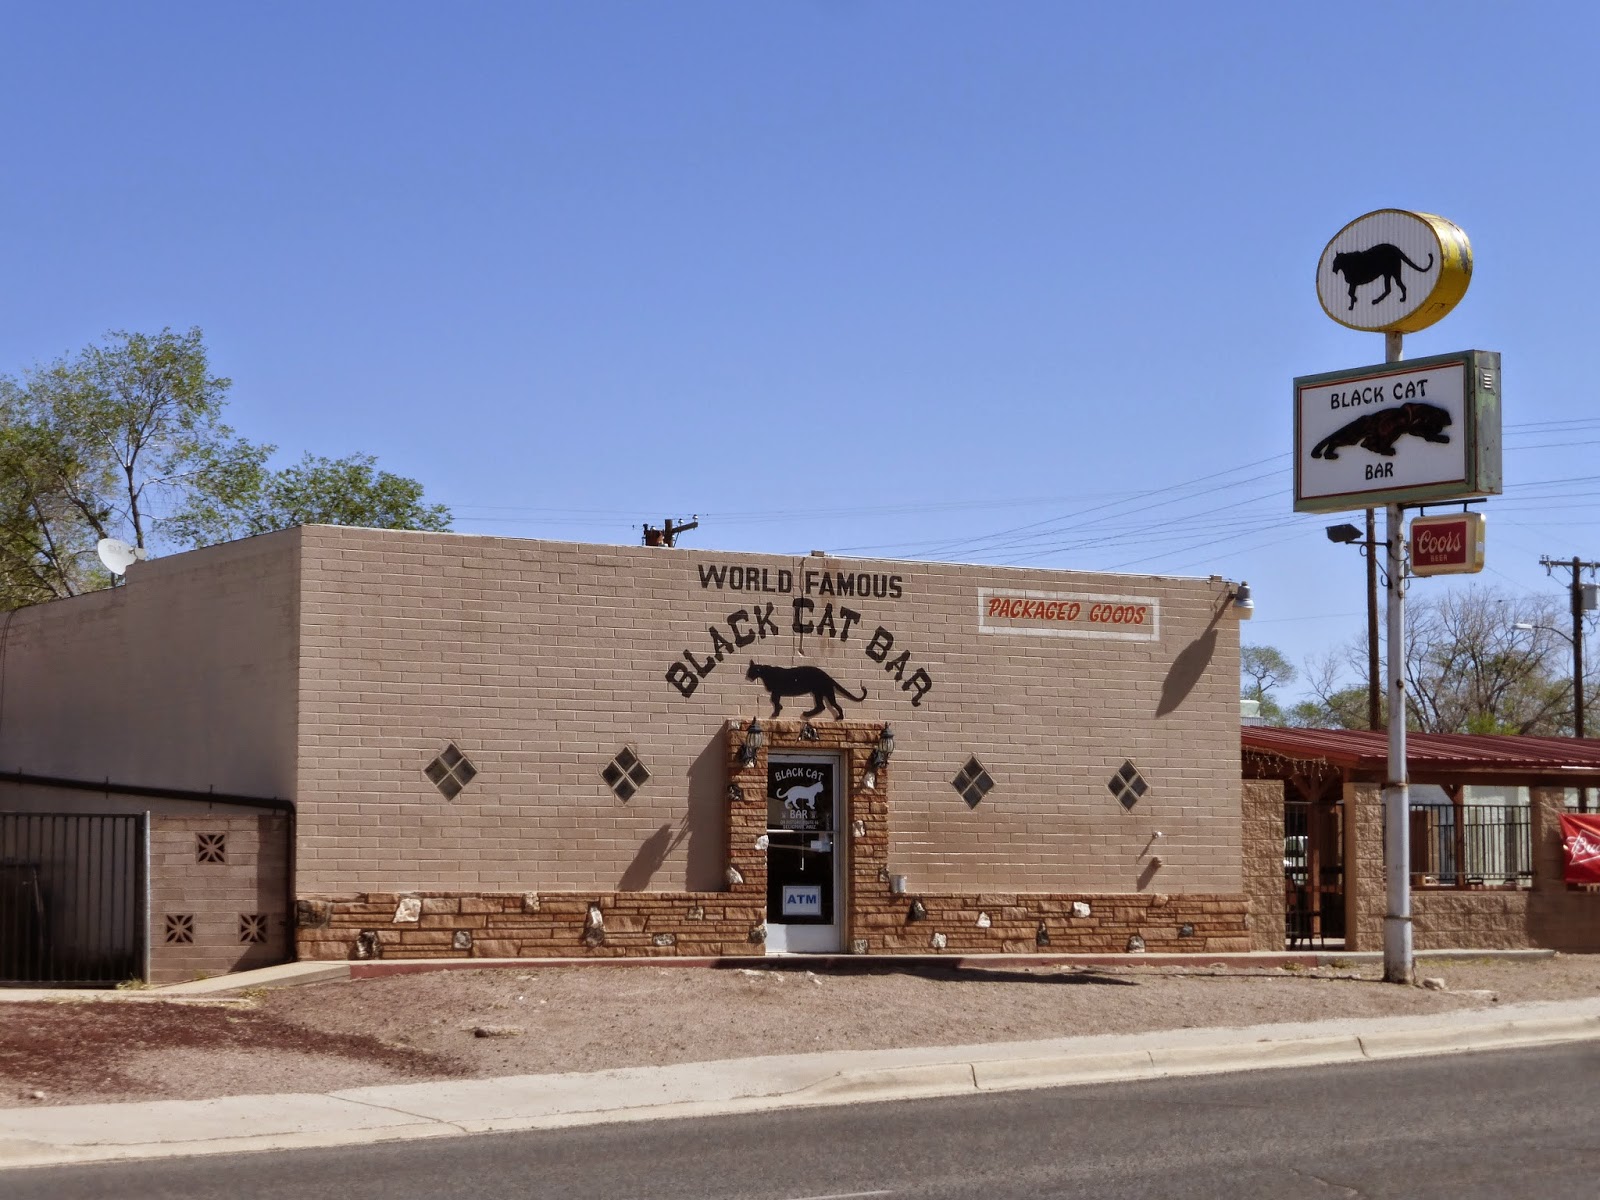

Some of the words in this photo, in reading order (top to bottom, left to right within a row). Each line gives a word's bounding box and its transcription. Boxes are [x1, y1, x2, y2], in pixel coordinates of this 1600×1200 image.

[1330, 386, 1384, 410] BLACK
[1393, 379, 1428, 400] CAT
[1365, 462, 1394, 480] BAR
[1417, 530, 1462, 554] Coors
[1430, 554, 1448, 562] BEER
[698, 564, 792, 593] WORLD
[805, 571, 902, 598] FAMOUS
[988, 597, 1081, 621] PACKAGED
[1089, 604, 1146, 624] GOODS
[665, 602, 778, 698] BLACK
[792, 598, 861, 642] CAT
[865, 626, 932, 707] BAR
[775, 767, 804, 781] BLACK
[805, 768, 824, 781] CAT
[790, 809, 808, 819] BAR
[787, 894, 817, 904] ATM
